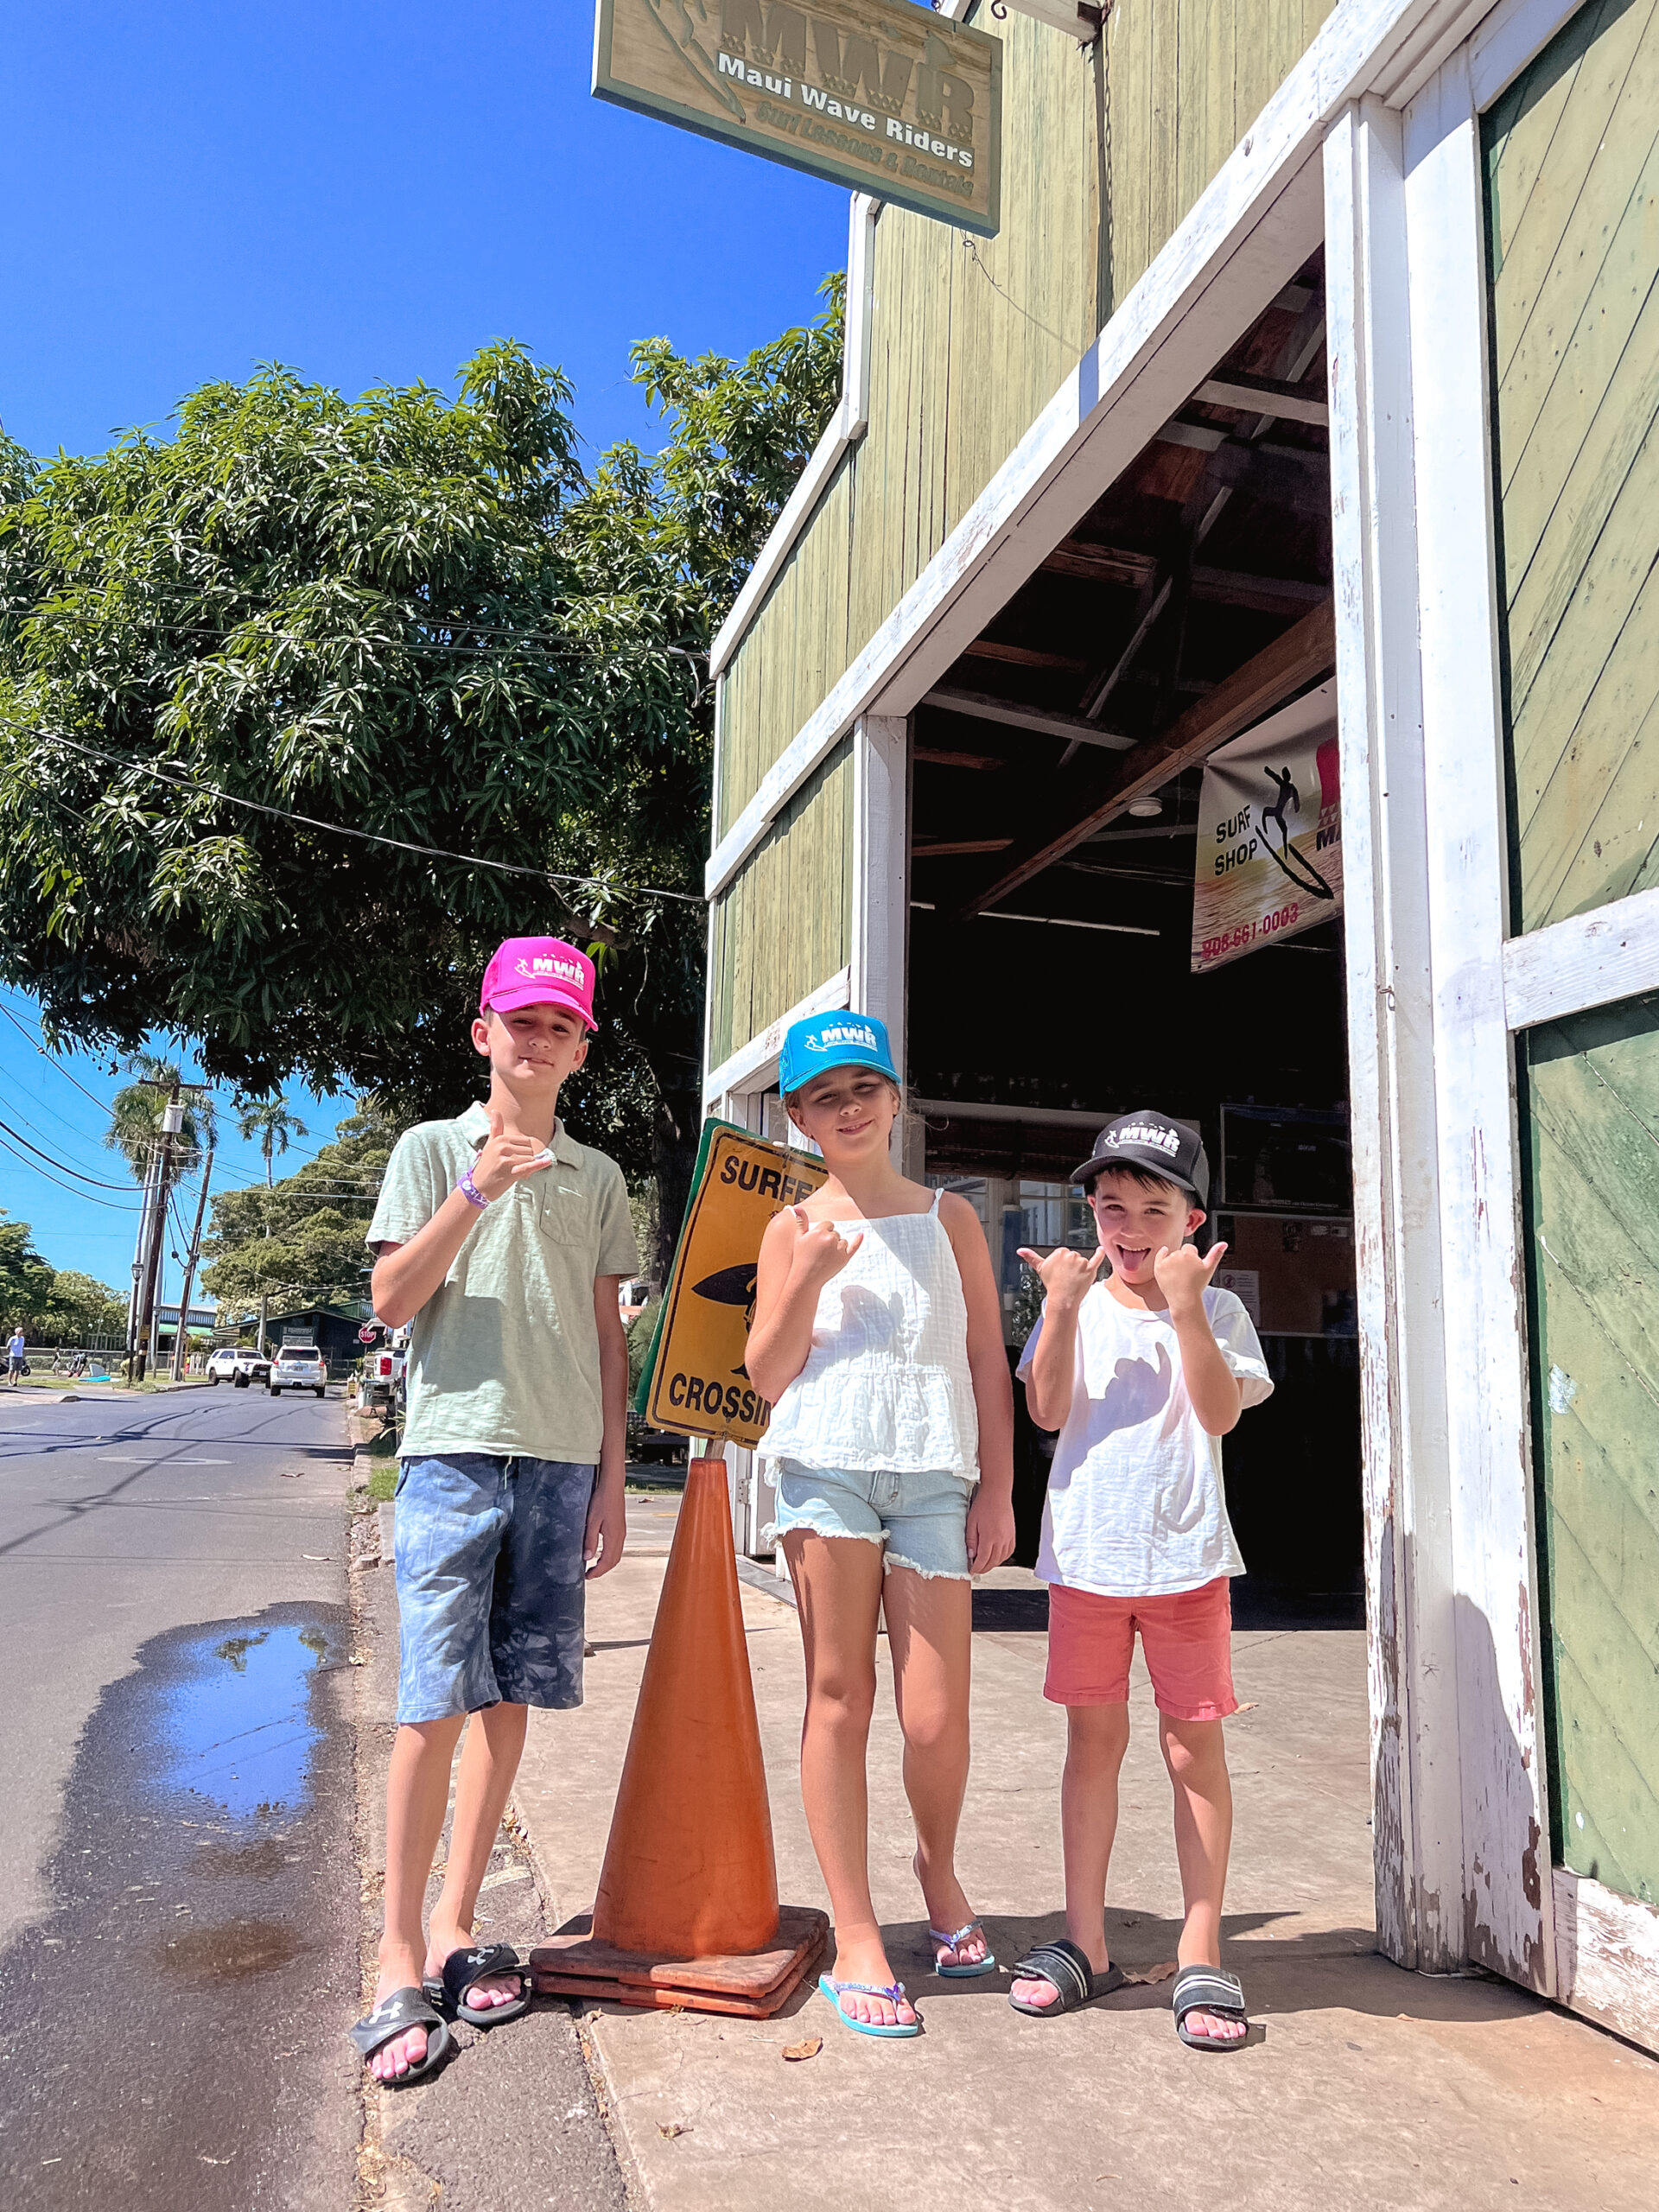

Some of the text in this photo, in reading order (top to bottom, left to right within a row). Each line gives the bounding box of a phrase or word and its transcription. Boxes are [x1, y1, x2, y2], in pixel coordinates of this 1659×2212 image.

[721, 0, 975, 145] MWR
[718, 53, 974, 168] Maui Wave Riders
[756, 100, 975, 197] Surf Lessons & Rentals
[1216, 804, 1251, 843] SURF
[1214, 838, 1258, 876] SHOP
[532, 957, 585, 985] MWR
[821, 1027, 876, 1046] MWR
[1119, 1126, 1181, 1151] MWR
[721, 1155, 819, 1205] SURFE
[670, 1372, 771, 1427] CROSSIN
